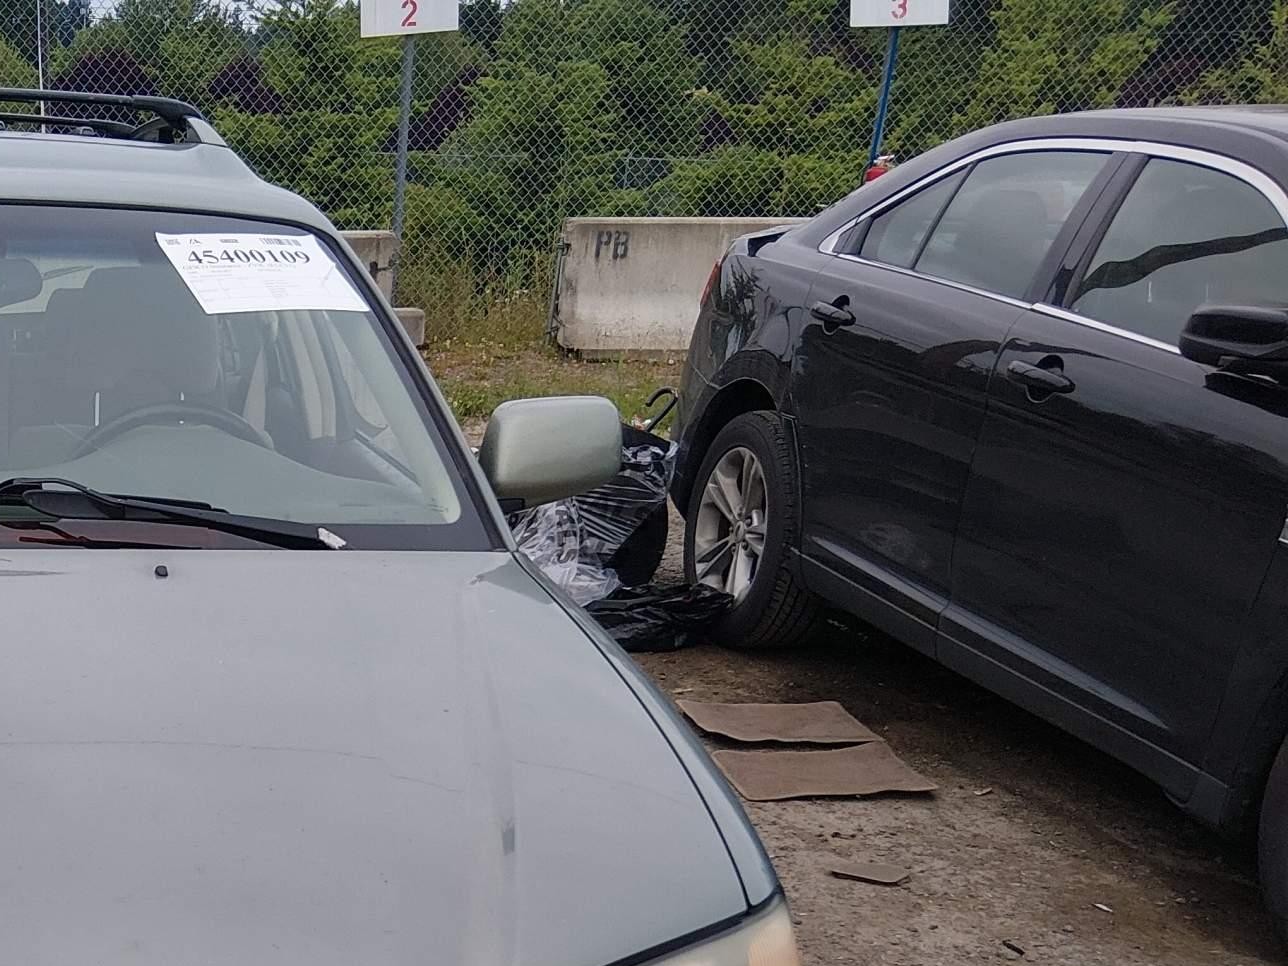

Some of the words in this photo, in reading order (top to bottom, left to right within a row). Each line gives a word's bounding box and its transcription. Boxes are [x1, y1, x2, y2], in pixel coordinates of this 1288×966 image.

[401, 0, 417, 27] 2
[891, 0, 907, 19] 3
[188, 249, 310, 264] 45400109
[594, 230, 630, 260] PB
